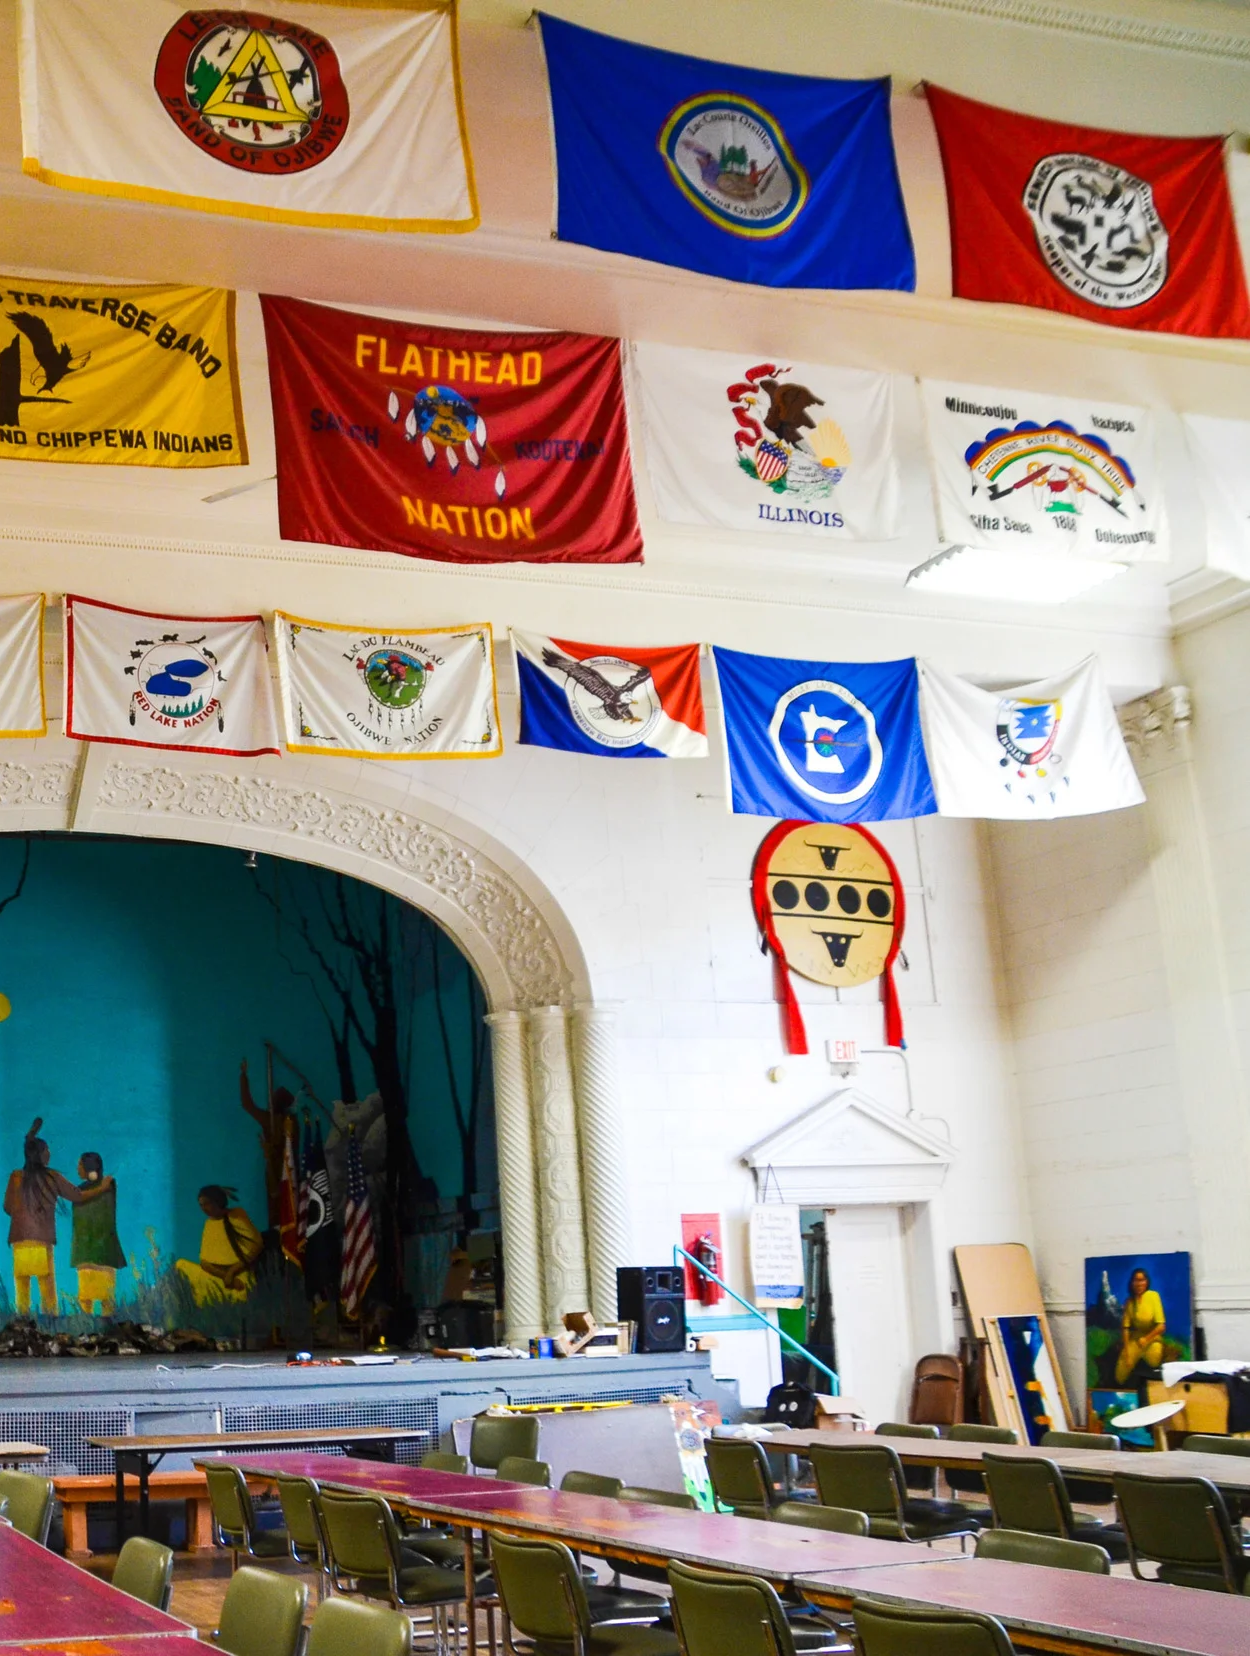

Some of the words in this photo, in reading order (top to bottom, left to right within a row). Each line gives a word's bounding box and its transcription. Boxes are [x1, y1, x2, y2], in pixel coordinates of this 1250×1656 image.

[166, 96, 221, 148] BAND
[229, 146, 264, 166] OF
[273, 113, 342, 168] OJIBWE
[6, 289, 157, 338] TRAVERSE
[154, 321, 223, 380] BAND
[355, 333, 542, 388] FLATHEAD
[36, 429, 147, 450] CHIPPEWA
[153, 429, 234, 453] INDIANS
[978, 440, 1021, 475] CHEYENNE
[1026, 434, 1060, 446] RIVER
[400, 495, 536, 541] NATION
[757, 502, 844, 529] ILLINOIS
[361, 636, 378, 648] DU
[381, 635, 446, 666] FLAMBEAU
[134, 690, 151, 712] RED
[150, 710, 178, 728] LAKE
[183, 697, 220, 728] NATION
[346, 712, 392, 745] OJIBWE
[403, 715, 444, 745] NATION
[596, 733, 610, 745] Bay
[999, 732, 1027, 762] INDIAN
[835, 1040, 856, 1060] EXIT
